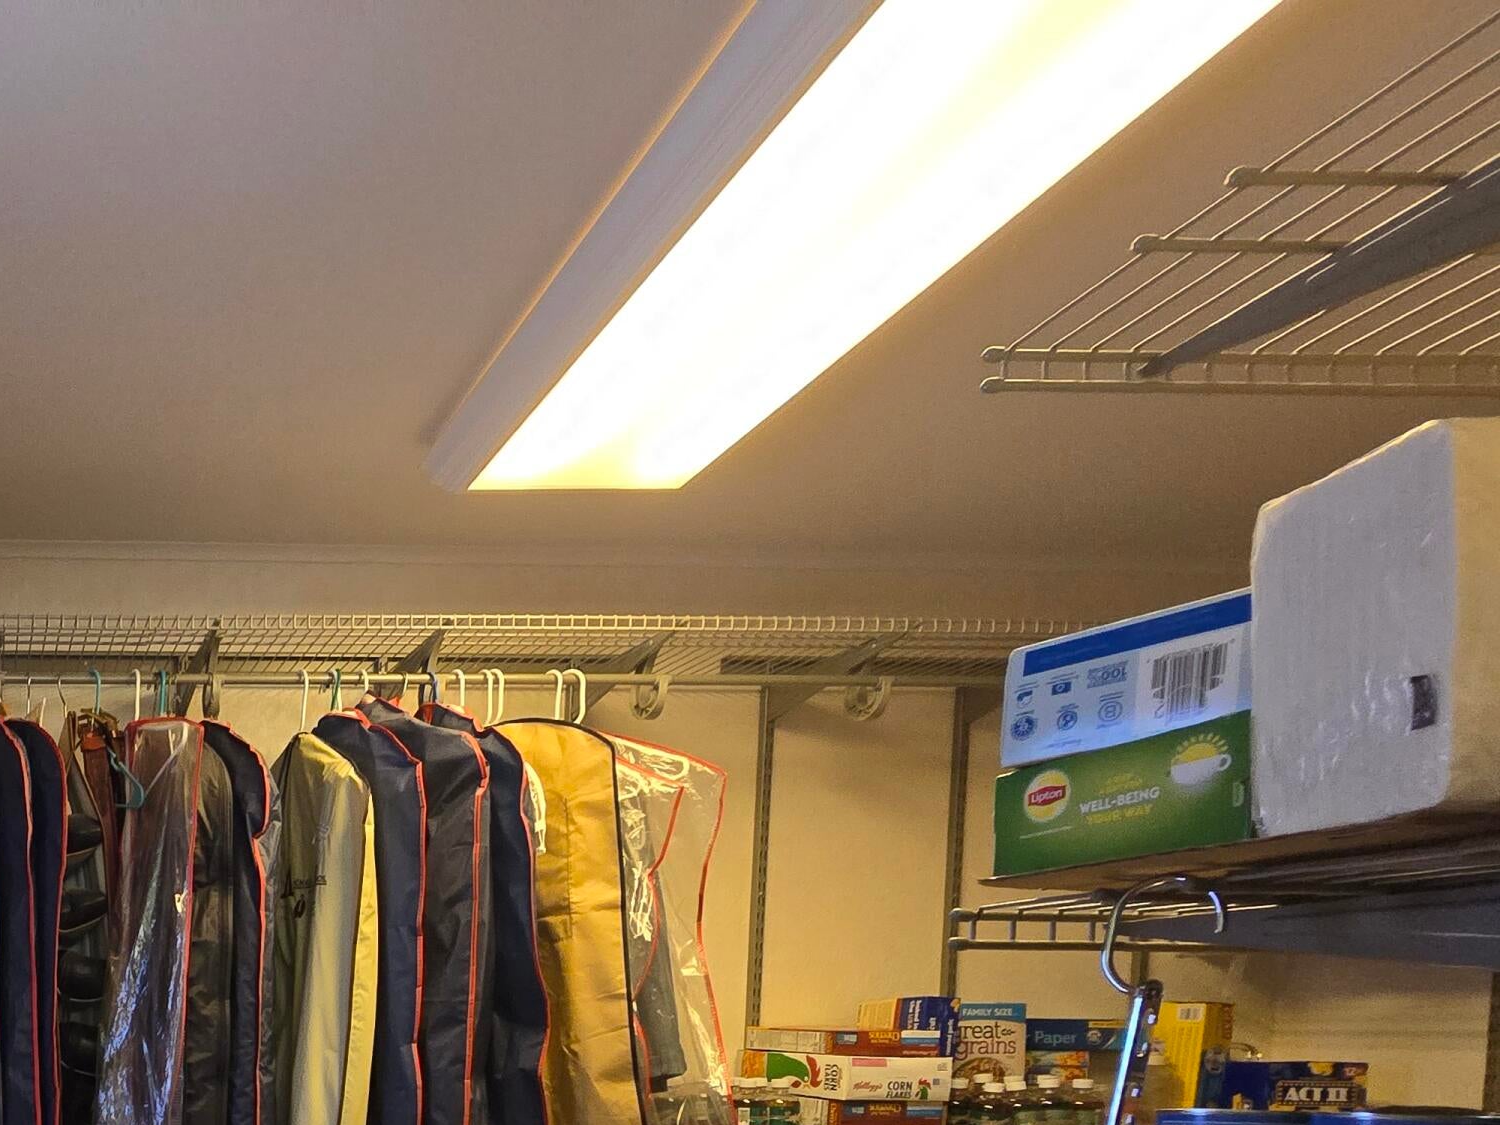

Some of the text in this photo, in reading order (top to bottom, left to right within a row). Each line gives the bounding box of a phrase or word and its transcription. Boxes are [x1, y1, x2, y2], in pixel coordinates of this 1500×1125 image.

[1031, 787, 1063, 805] Lipton
[1079, 787, 1161, 814] WELL-BEING
[962, 1008, 1013, 1017] FAMILY SIZE
[959, 1021, 1001, 1040] reat
[1034, 1030, 1077, 1047] Paper
[955, 1038, 1016, 1061] grains
[829, 1063, 839, 1092] CORN
[887, 1080, 913, 1091] CORN
[885, 1090, 912, 1099] FLAKES
[1285, 1087, 1349, 1103] ACT II
